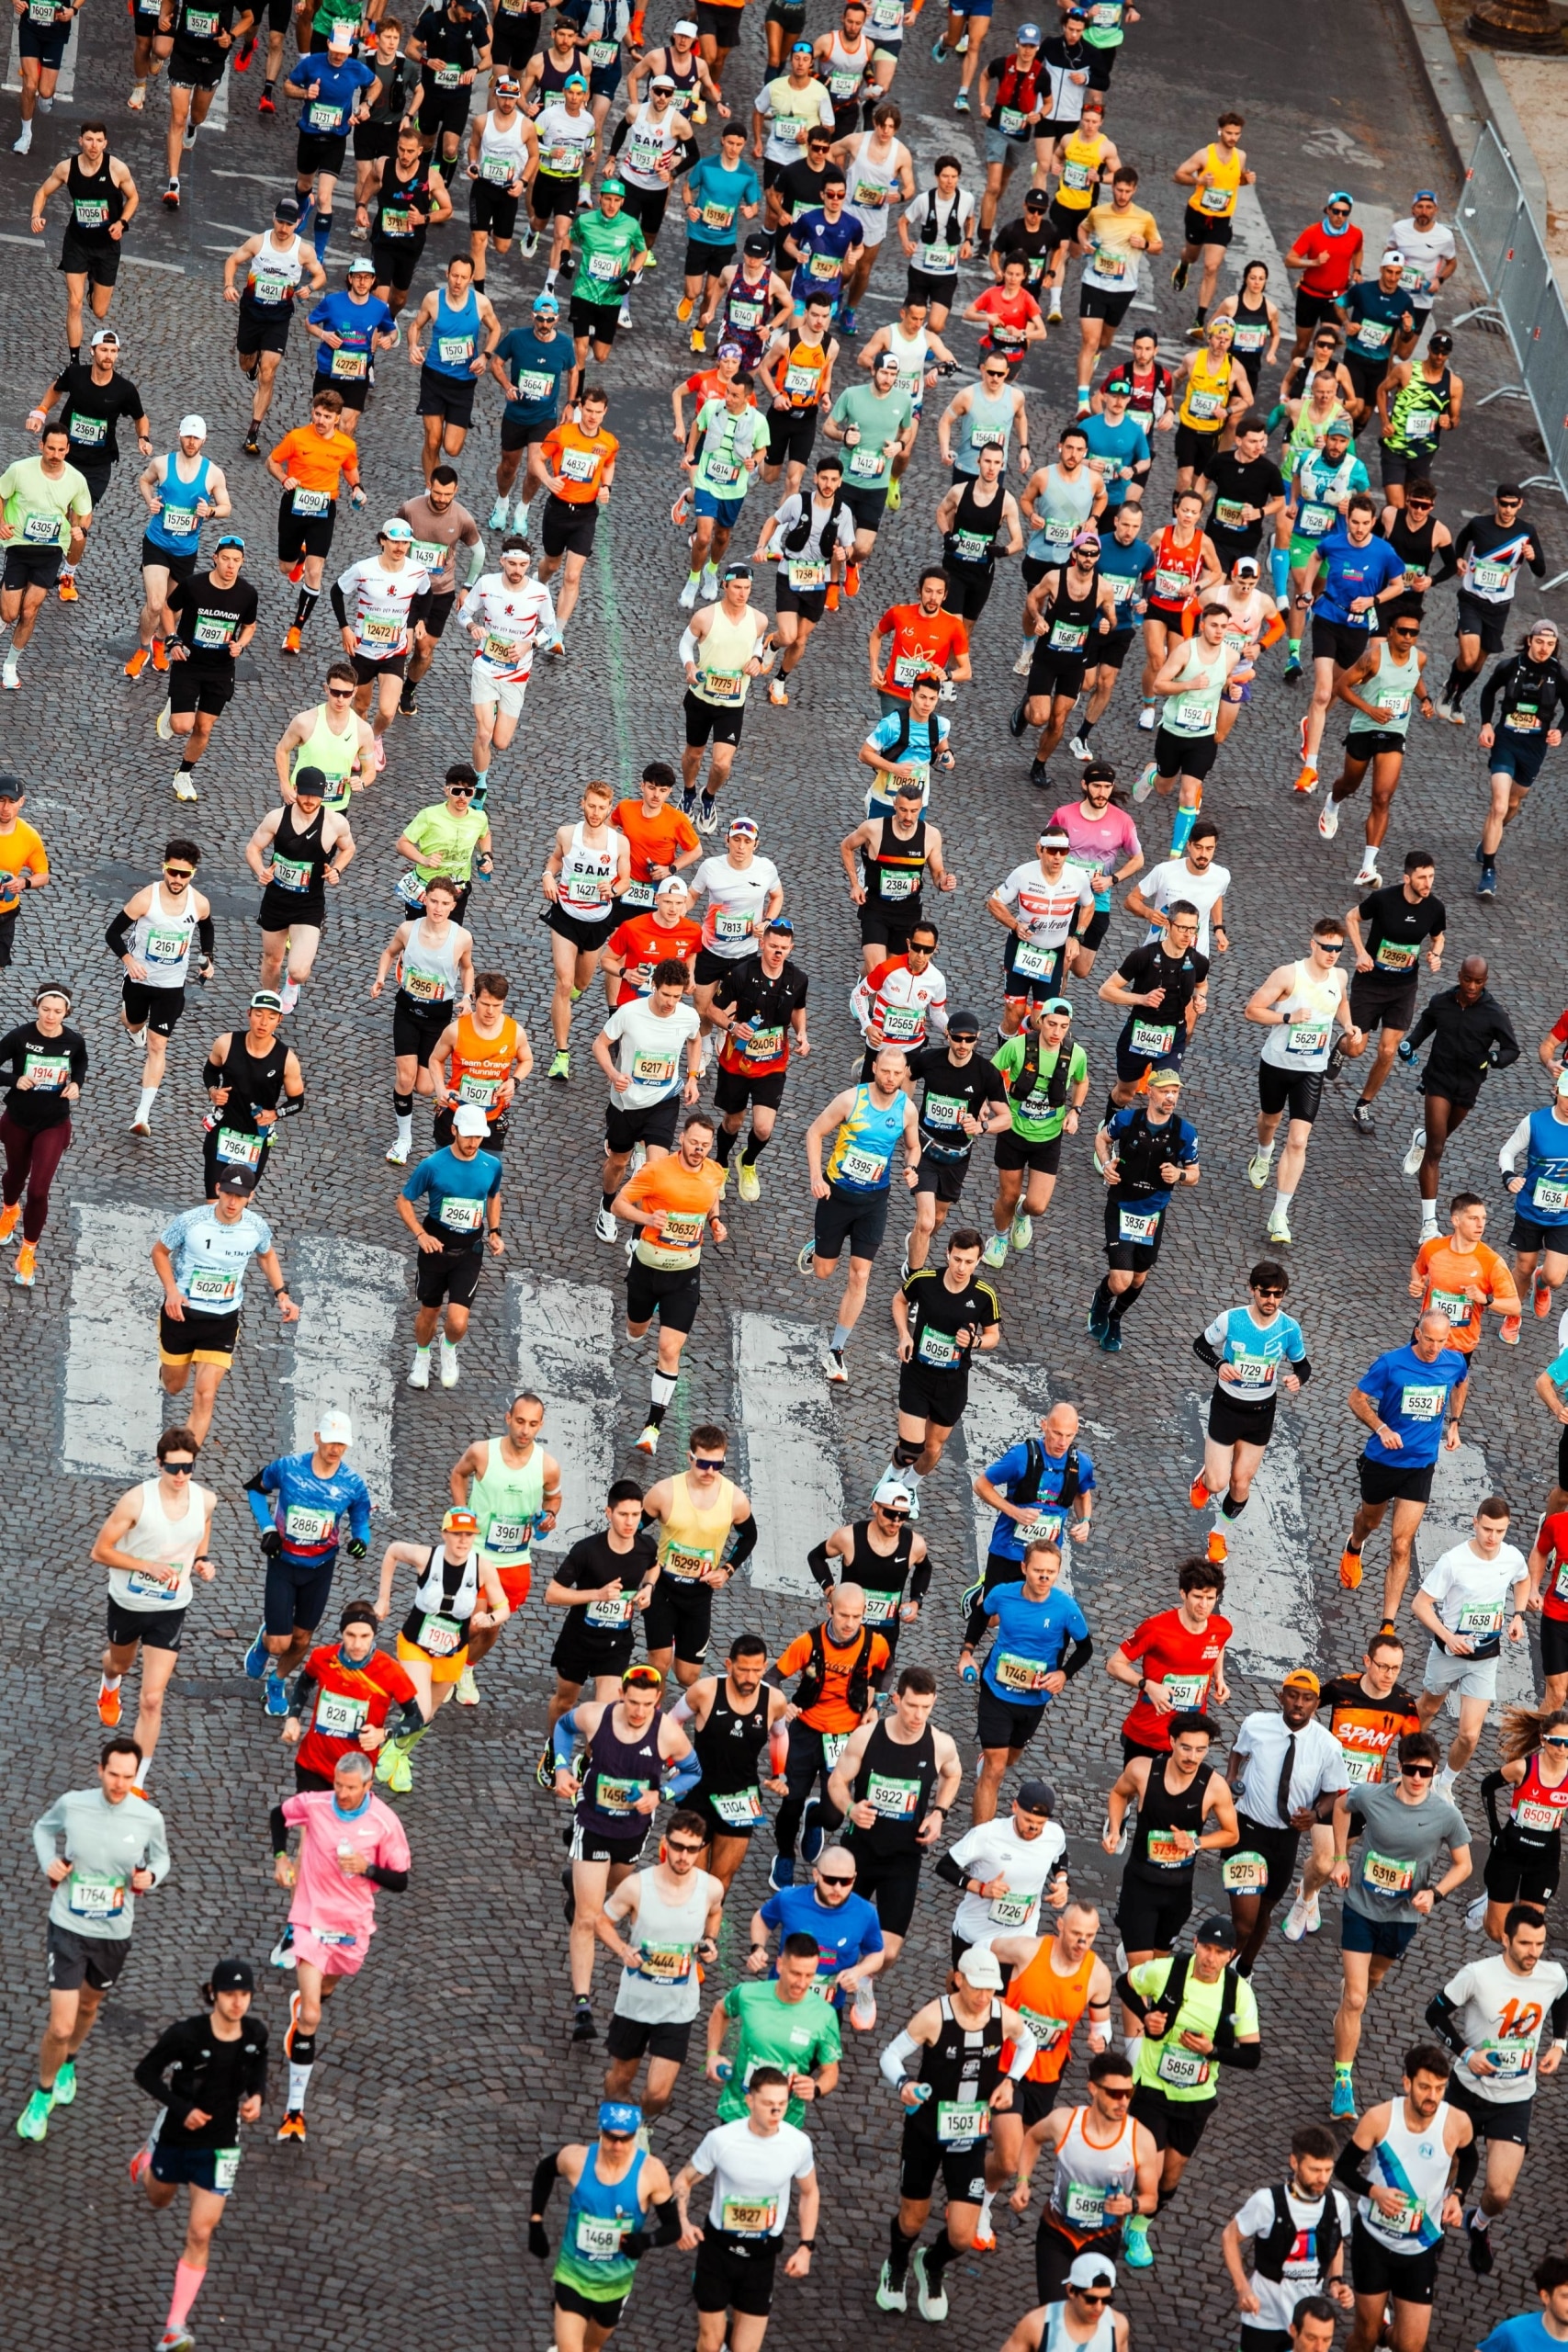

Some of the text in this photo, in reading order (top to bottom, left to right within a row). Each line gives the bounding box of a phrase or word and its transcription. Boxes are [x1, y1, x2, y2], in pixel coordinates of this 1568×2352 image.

[32, 6, 52, 17] 16097
[191, 17, 208, 28] 3572
[593, 49, 607, 59] 1497
[438, 71, 457, 82] 21428
[315, 112, 330, 122] 1731
[781, 124, 795, 133] 1559
[636, 134, 663, 148] SAM
[636, 153, 649, 164] 1793
[490, 166, 503, 175] 1775
[78, 208, 99, 219] 17056
[707, 210, 725, 221] 15136
[593, 261, 611, 271] 5920
[260, 285, 277, 295] 4821
[735, 311, 751, 321] 6740
[446, 345, 462, 356] 1570
[335, 359, 358, 370] 42725
[524, 379, 542, 390] 3664
[792, 375, 807, 386] 7675
[1195, 400, 1211, 410] 3663
[75, 424, 95, 435] 2369
[567, 460, 586, 470] 4832
[858, 458, 873, 468] 1412
[711, 464, 728, 474] 4814
[299, 494, 319, 505] 4090
[1221, 507, 1240, 519] 11867
[167, 514, 190, 525] 15756
[1306, 515, 1322, 527] 7628
[31, 522, 51, 533] 4305
[1051, 528, 1068, 538] 2699
[416, 550, 434, 561] 1439
[795, 570, 812, 579] 1738
[1483, 571, 1497, 582] 6111
[197, 608, 239, 620] SALOMON
[201, 628, 220, 639] 7897
[367, 626, 389, 638] 12472
[1058, 632, 1076, 642] 1685
[490, 642, 508, 656] 3790
[711, 677, 732, 688] 17775
[1385, 699, 1400, 709] 1519
[1184, 708, 1201, 719] 1592
[279, 865, 297, 879] 1767
[574, 864, 609, 876] SAM
[403, 876, 419, 892] 2921
[577, 883, 595, 896] 1427
[886, 879, 908, 890] 2384
[628, 888, 649, 899] 2838
[1021, 900, 1073, 910] TREK
[722, 922, 741, 933] 7813
[155, 940, 175, 952] 2161
[1022, 955, 1042, 967] 7467
[1382, 949, 1406, 962] 12369
[411, 978, 432, 992] 2956
[888, 1017, 913, 1030] 12565
[1137, 1032, 1162, 1044] 18449
[1296, 1034, 1316, 1044] 5629
[748, 1038, 774, 1050] 42406
[460, 1058, 481, 1067] Team
[641, 1062, 661, 1073] 6217
[33, 1068, 53, 1079] 1914
[469, 1068, 501, 1077] Running
[467, 1087, 488, 1099] 1507
[932, 1105, 953, 1116] 6909
[225, 1141, 245, 1155] 7964
[849, 1158, 871, 1173] 3395
[1542, 1190, 1562, 1203] 1636
[446, 1208, 469, 1220] 2964
[1125, 1216, 1145, 1229] 3836
[666, 1222, 694, 1235] 30632
[206, 1239, 211, 1250] 1
[197, 1281, 222, 1293] 5020
[1438, 1301, 1457, 1314] 1661
[926, 1341, 949, 1357] 8056
[1240, 1364, 1260, 1375] 1729
[1408, 1397, 1432, 1408] 5532
[292, 1519, 318, 1532] 2886
[496, 1524, 519, 1538] 3961
[1021, 1524, 1046, 1537] 4740
[670, 1554, 700, 1571] 16299
[596, 1602, 620, 1614] 4619
[1469, 1614, 1490, 1625] 1638
[429, 1629, 451, 1645] 1910
[1005, 1665, 1026, 1681] 1746
[327, 1706, 346, 1722] 828
[829, 1744, 846, 1758] 164
[603, 1788, 626, 1802] 1456
[875, 1790, 902, 1804] 5922
[721, 1801, 746, 1814] 3104
[1524, 1808, 1551, 1822] 8509
[1230, 1864, 1254, 1879] 5275
[1372, 1866, 1395, 1882] 6318
[81, 1888, 107, 1902] 1764
[998, 1904, 1021, 1917] 1726
[1167, 2061, 1195, 2075] 5858
[948, 2116, 974, 2129] 1503
[732, 2208, 761, 2221] 3827
[587, 2229, 613, 2245] 1468
